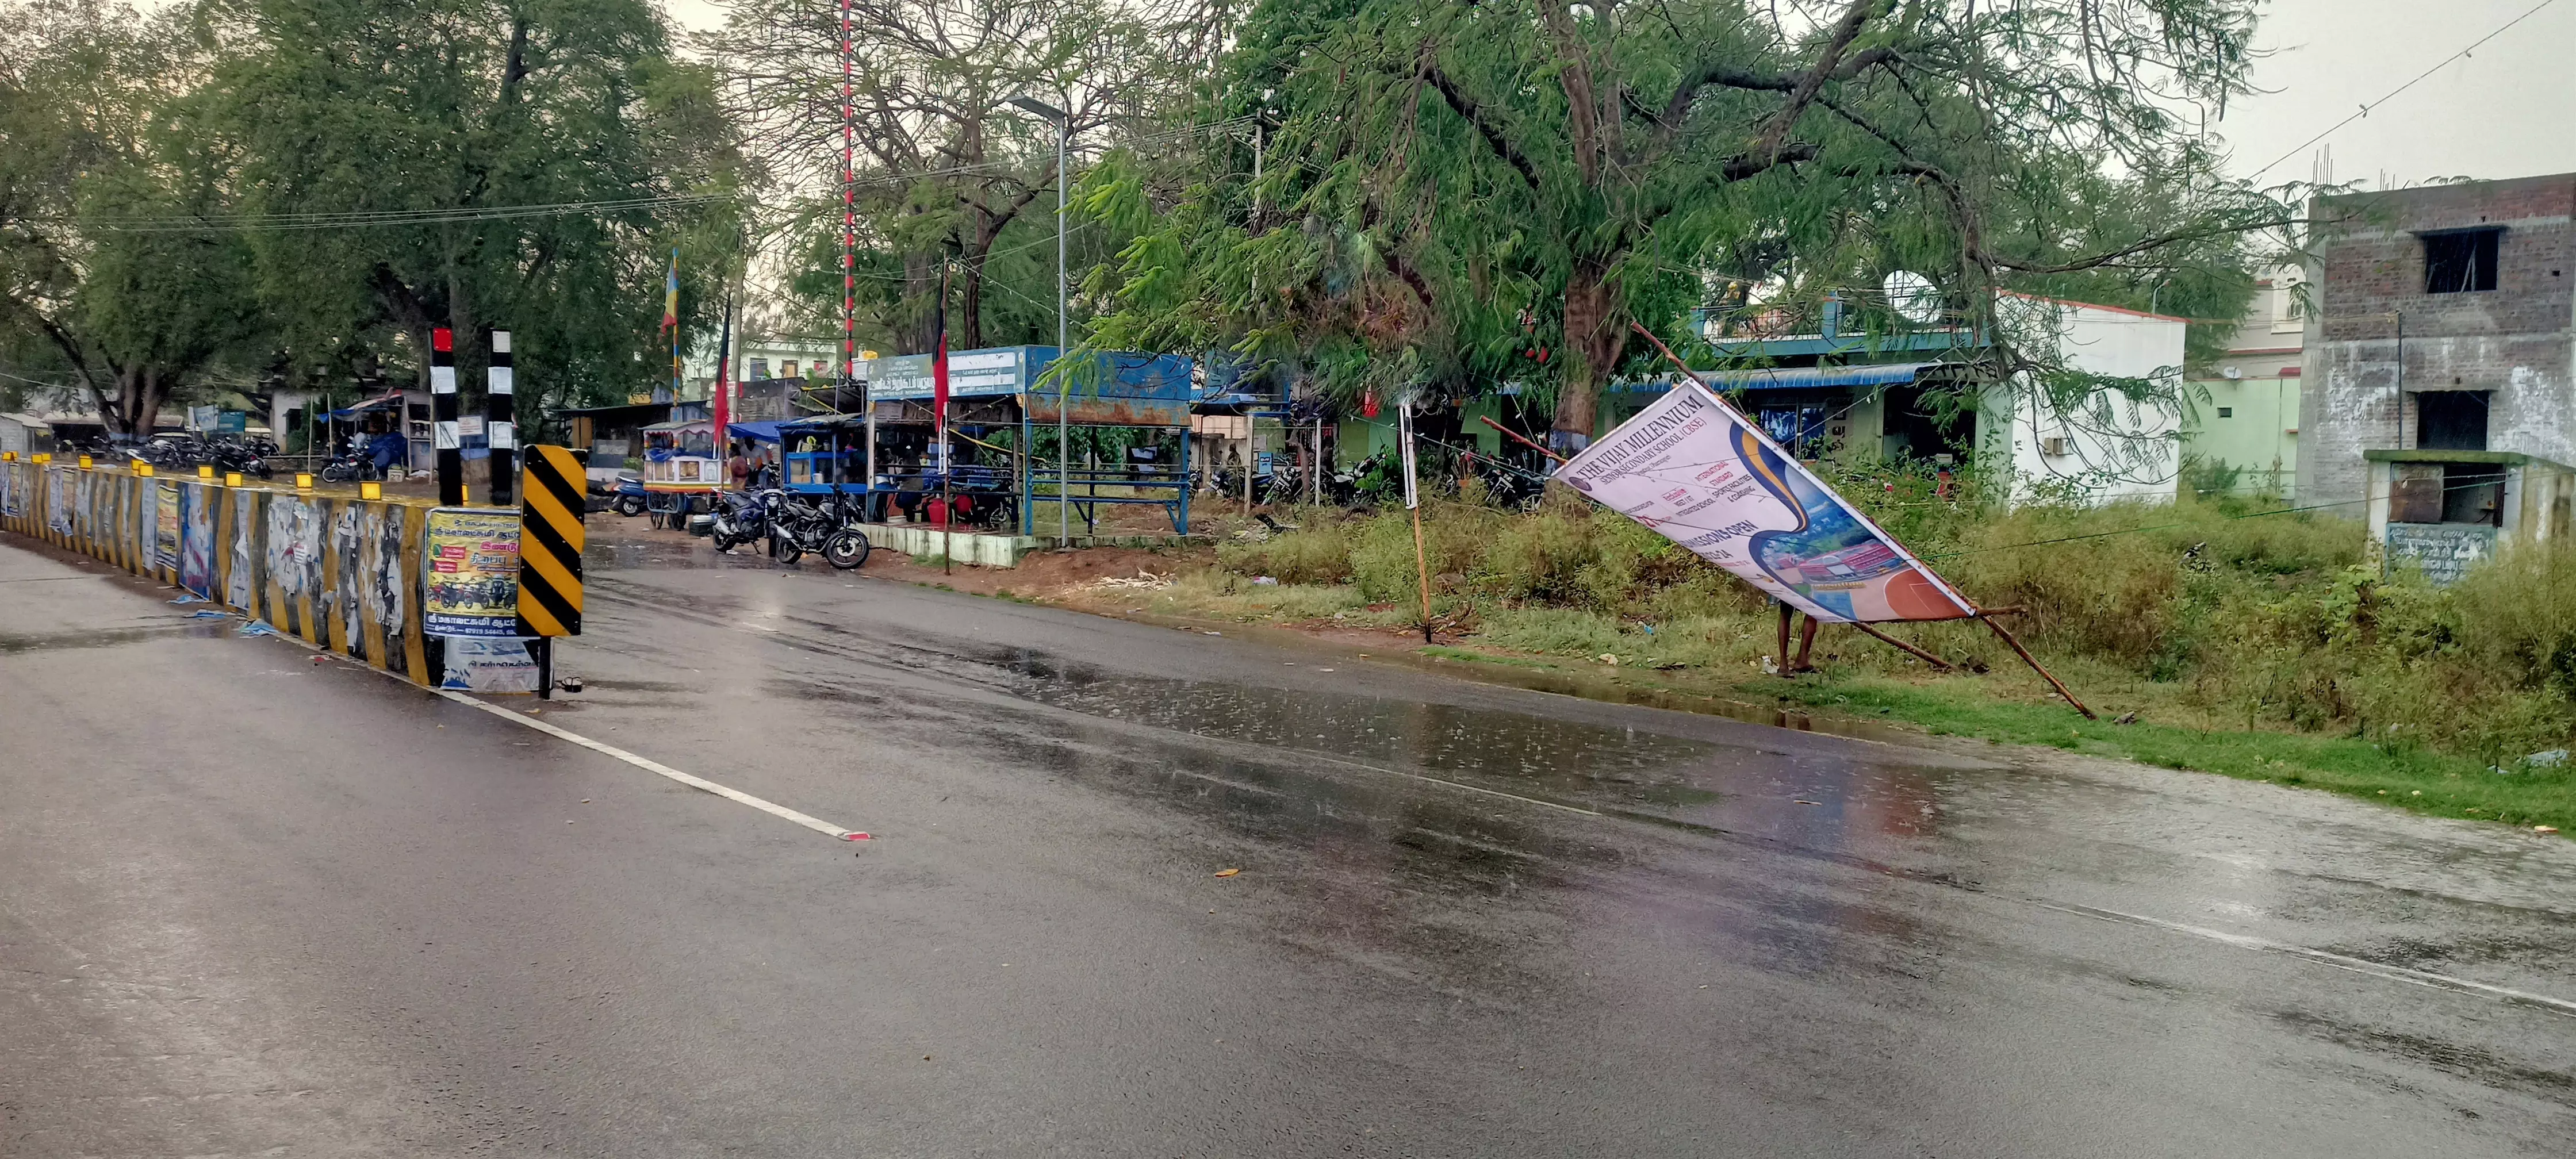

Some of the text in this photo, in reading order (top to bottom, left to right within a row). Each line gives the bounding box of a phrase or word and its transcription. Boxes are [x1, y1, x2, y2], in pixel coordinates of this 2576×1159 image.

[1576, 460, 1603, 481] THE
[1598, 443, 1631, 469] VIJAY
[1624, 394, 1705, 453] MILLENNIUM
[1600, 468, 1625, 485] SENIOR
[1619, 448, 1657, 476] SECONDARY
[1653, 432, 1684, 458] SCHOOL
[1680, 417, 1708, 440] (CBSE)
[1711, 474, 1753, 498] SPORTS FACILITIES
[1725, 520, 1759, 535] OPEN
